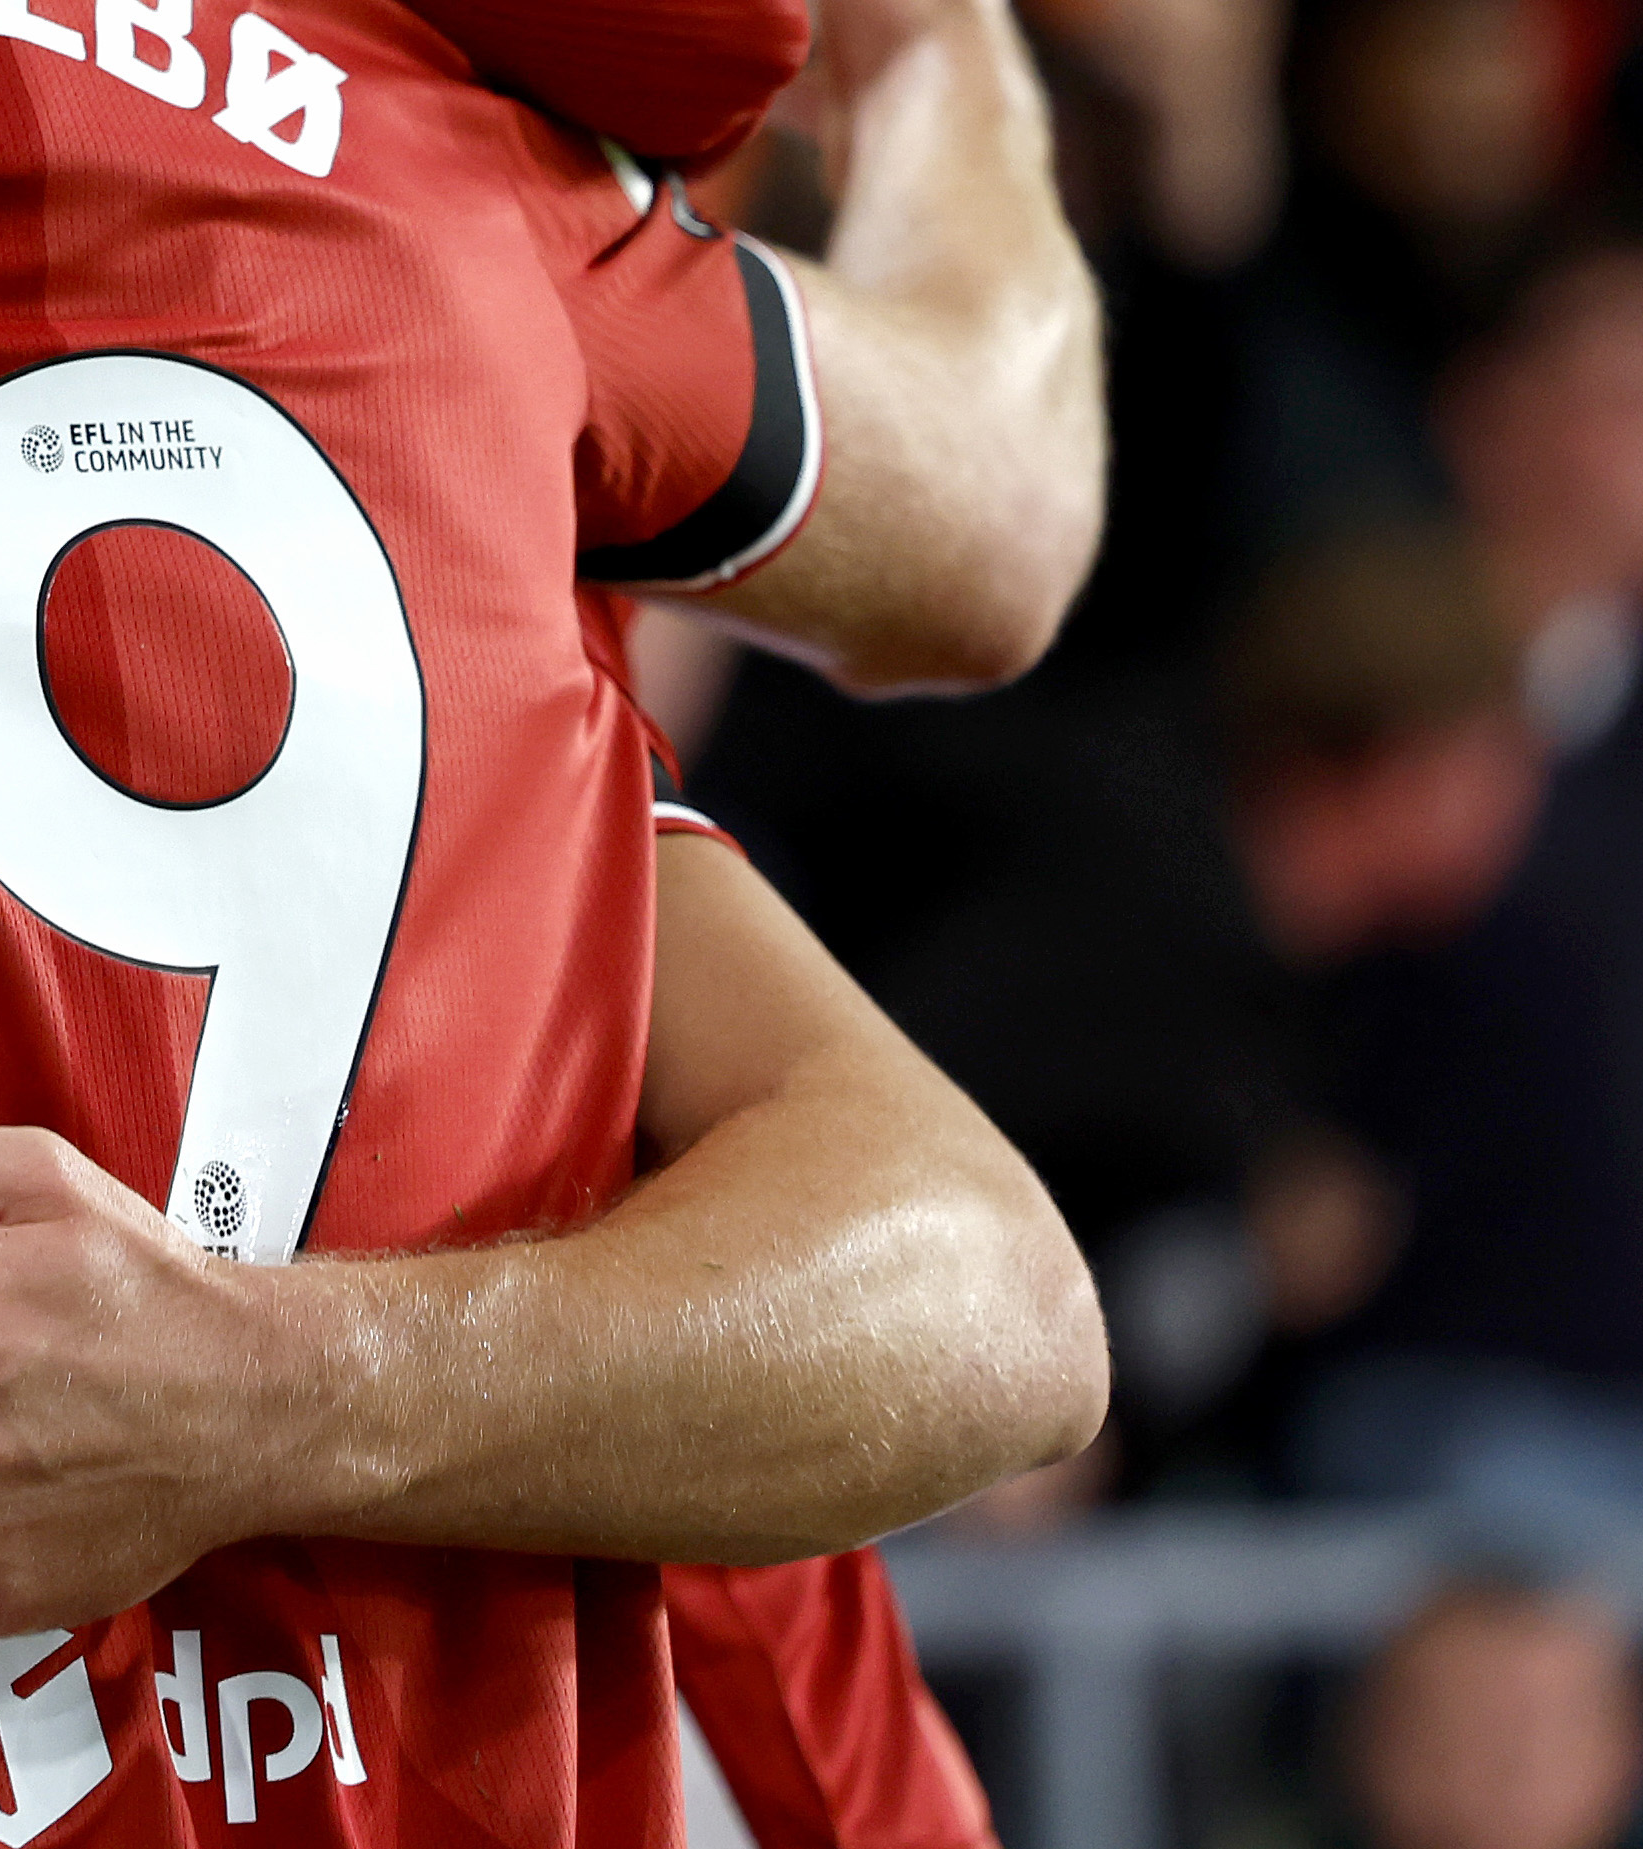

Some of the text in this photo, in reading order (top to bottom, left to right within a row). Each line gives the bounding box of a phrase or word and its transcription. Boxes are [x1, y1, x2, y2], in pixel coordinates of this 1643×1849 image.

[69, 419, 196, 446] EFL IN THE
[74, 446, 223, 473] COMMUNITY
[154, 1629, 368, 1825] dpd
